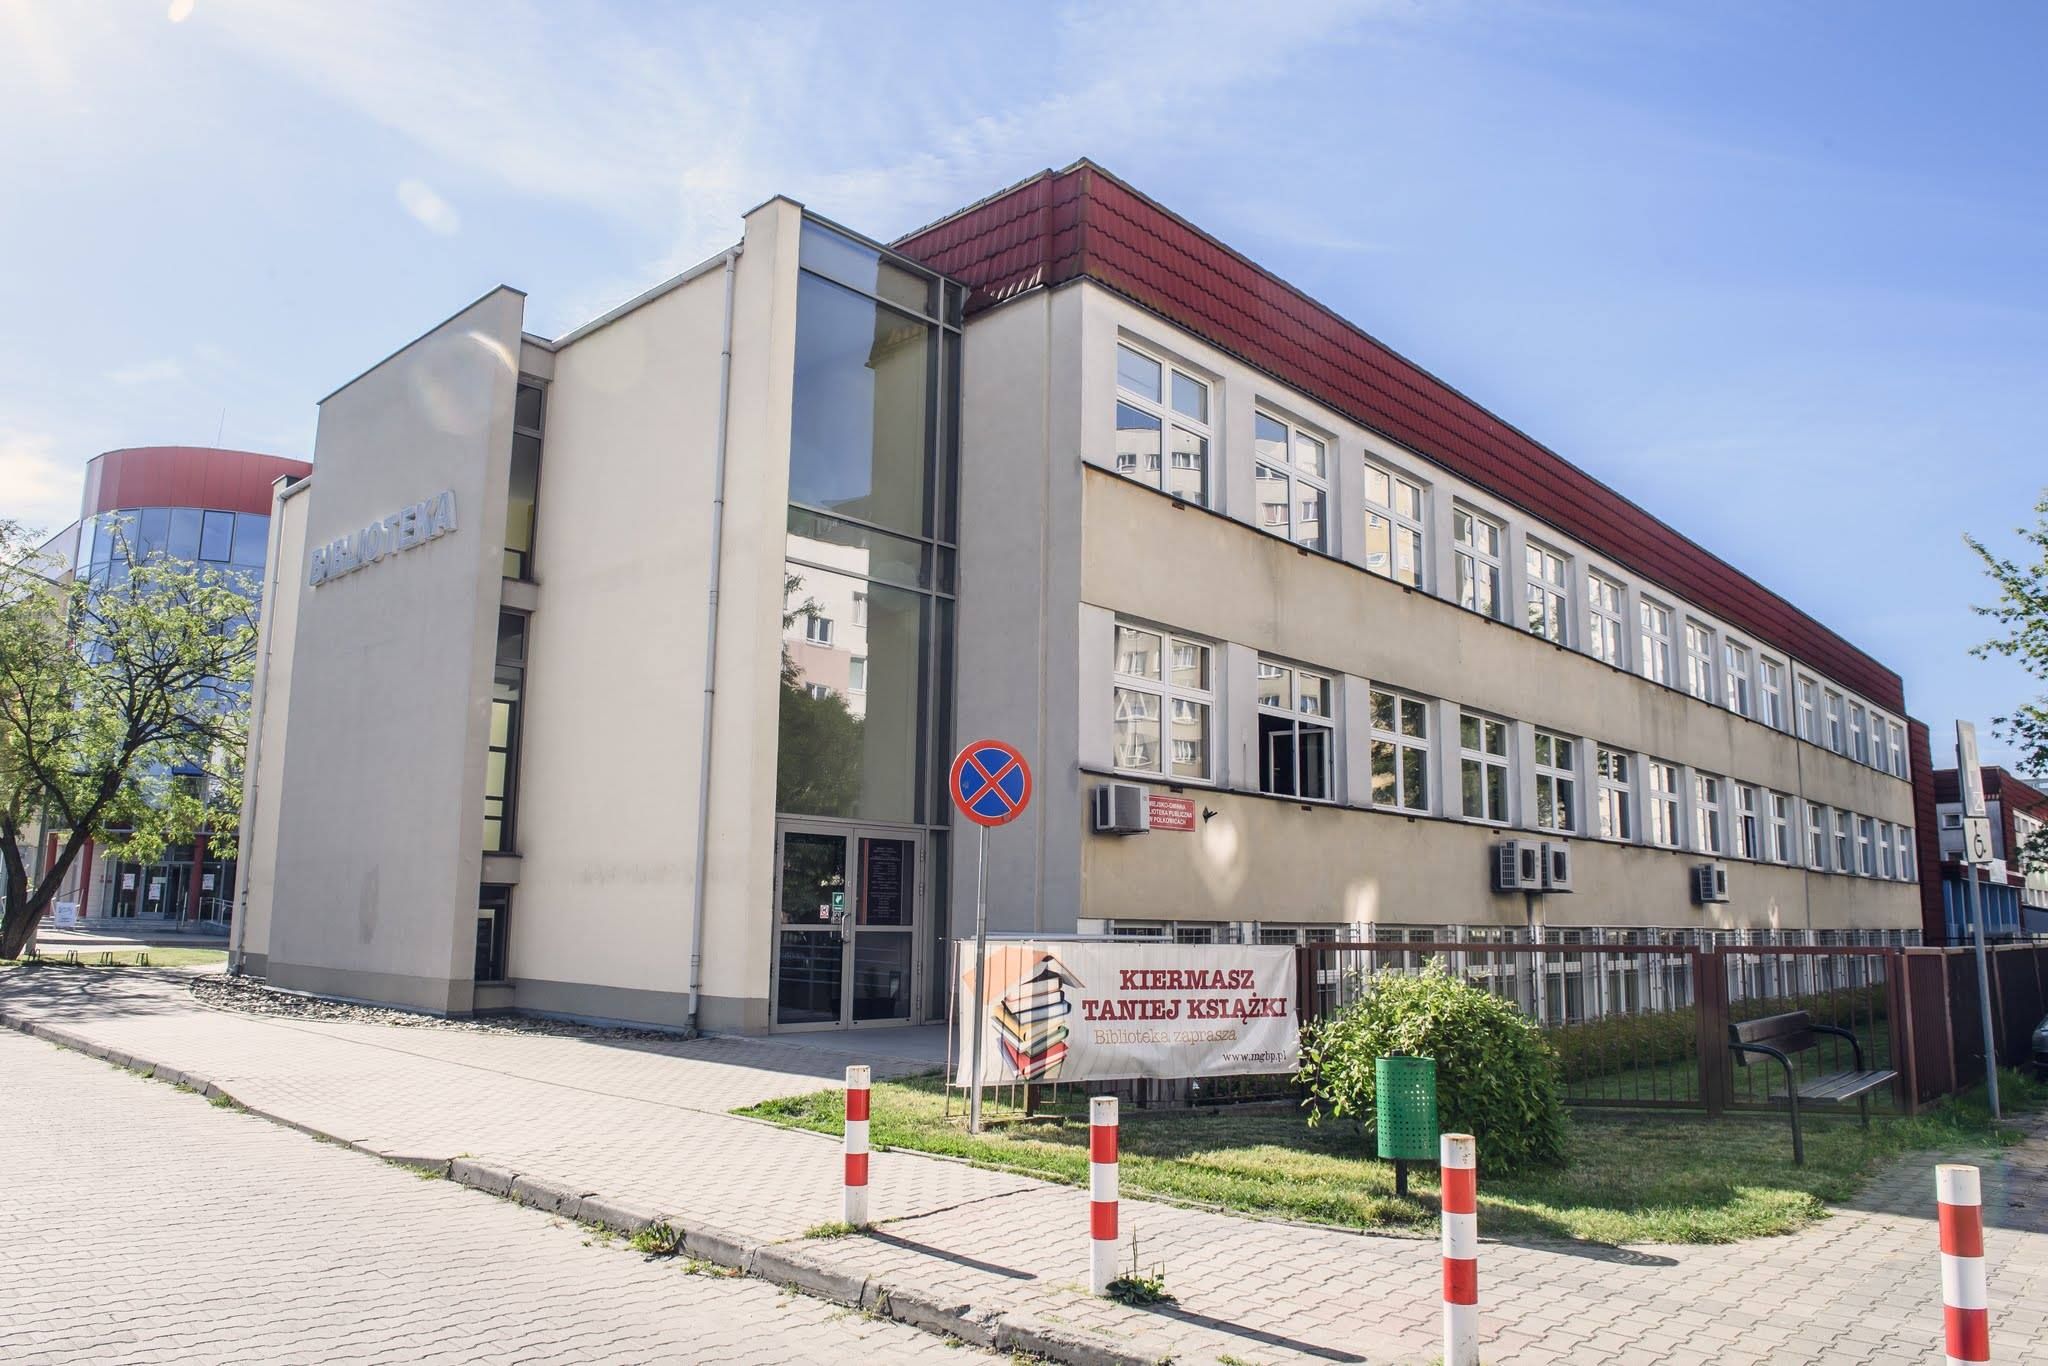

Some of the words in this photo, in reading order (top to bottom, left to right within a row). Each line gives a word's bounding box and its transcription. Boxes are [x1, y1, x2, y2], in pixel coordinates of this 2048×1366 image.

[309, 489, 458, 588] BIBLIOTEKA
[1119, 969, 1255, 990] KIERMASZ
[1081, 999, 1182, 1021] TANIEJ
[1186, 992, 1288, 1025] KSIĄŻKI
[1094, 1028, 1171, 1045] Biblioteka
[1173, 1028, 1238, 1046] zaprasza
[1222, 1049, 1287, 1063] www.mgbp.pl
